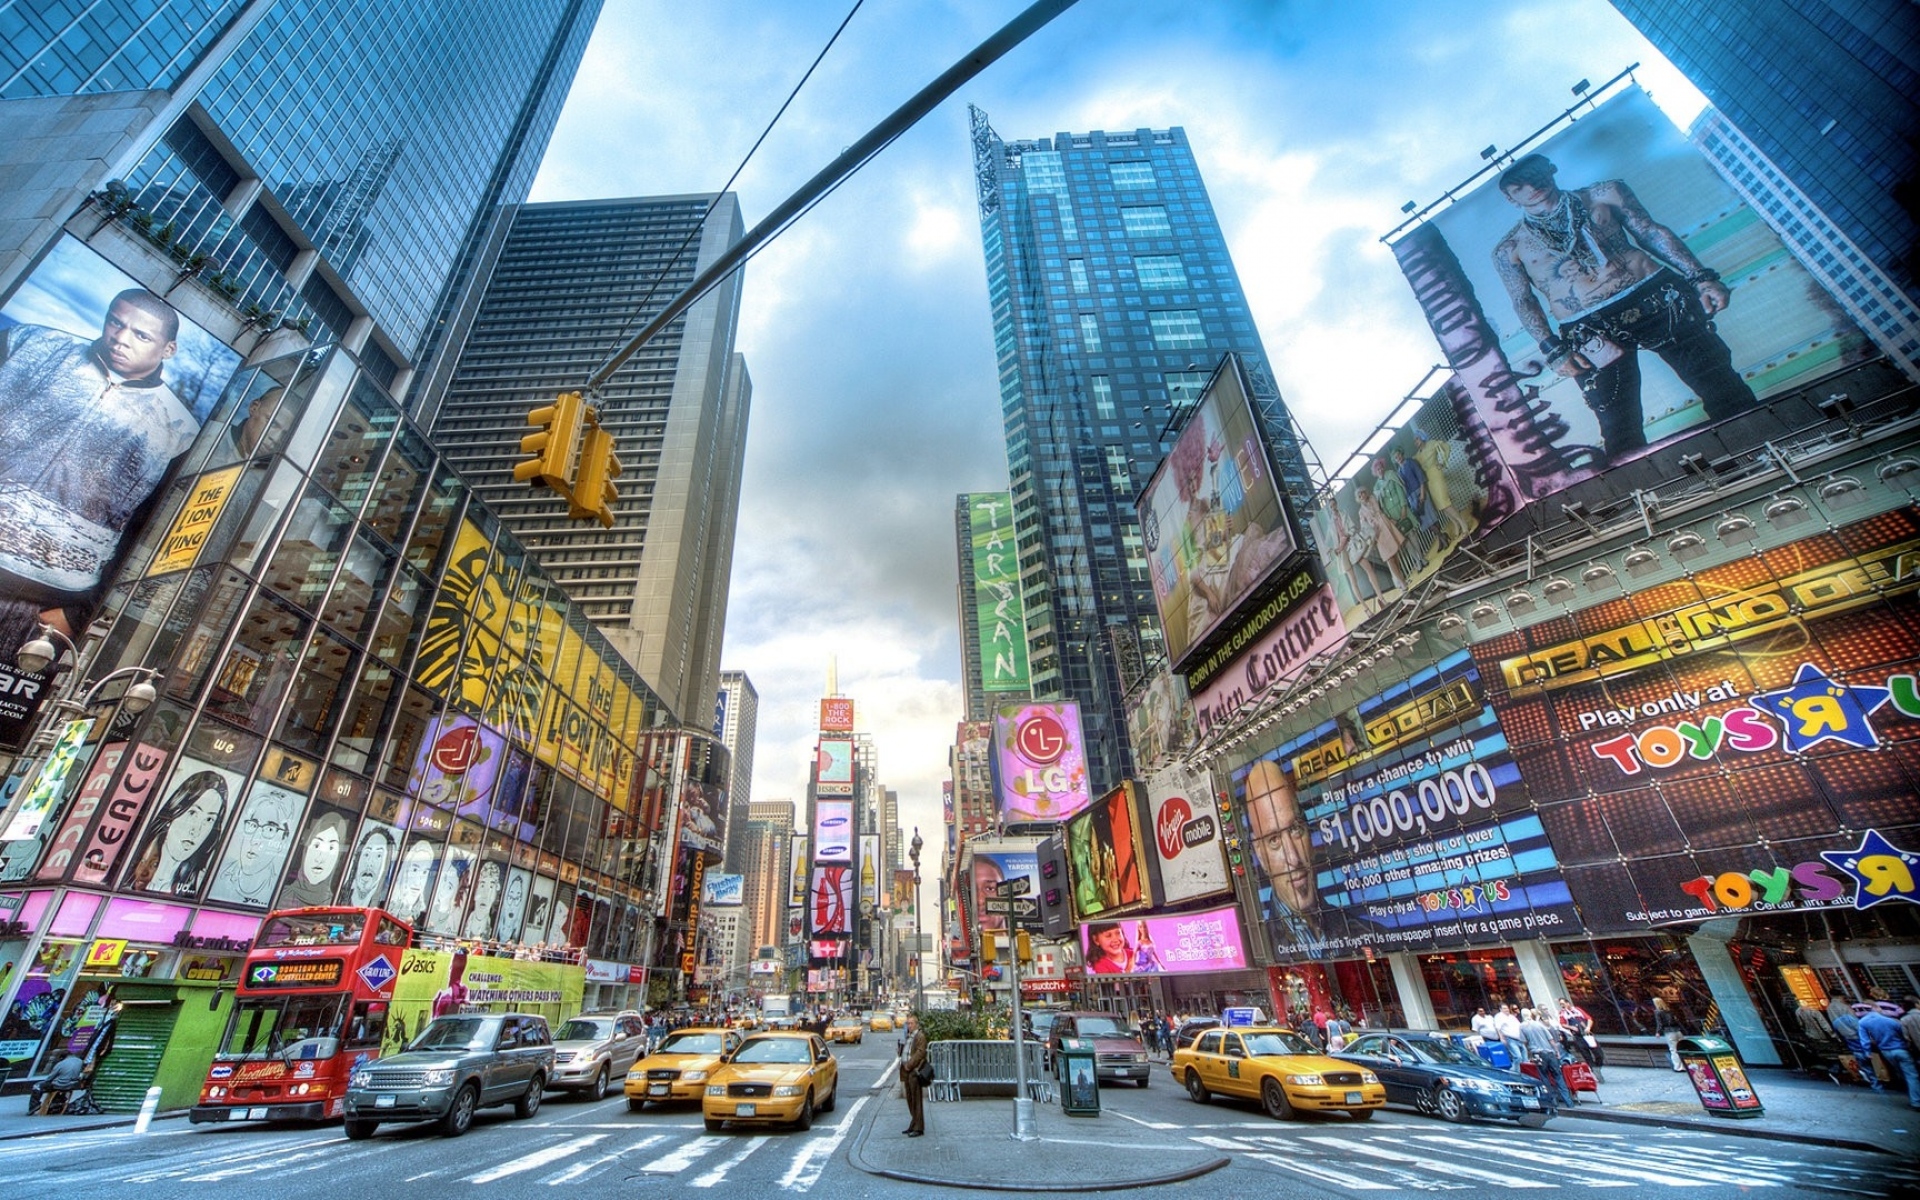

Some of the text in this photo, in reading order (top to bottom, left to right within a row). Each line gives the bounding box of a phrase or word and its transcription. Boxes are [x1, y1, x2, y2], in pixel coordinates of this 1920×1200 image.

[198, 487, 223, 503] THE
[176, 506, 218, 533] LION
[159, 532, 203, 561] KING
[1189, 571, 1314, 690] BORN IN THE GLAMOROUS USA
[1246, 596, 1339, 694] Couture
[1516, 632, 1657, 687] DEAL
[1681, 593, 1791, 640] NO
[588, 676, 611, 712] THE
[1578, 679, 1740, 732] Play only at
[547, 684, 594, 754] LION
[1367, 683, 1474, 745] NO DEAL
[213, 738, 235, 755] we
[1299, 742, 1345, 776] DEAL
[1592, 707, 1777, 775] TOYS
[337, 785, 351, 797] all
[1025, 767, 1068, 793] LG
[1322, 738, 1475, 806] Play for a chance to win
[46, 749, 123, 868] PEACE
[84, 751, 160, 872] PEACE
[1319, 762, 1497, 853] $1,000,000
[1160, 804, 1212, 852] Virgin mobile
[1341, 863, 1352, 874] or
[1361, 856, 1379, 873] trip
[1381, 854, 1391, 865] to
[1392, 848, 1412, 861] the
[1414, 843, 1448, 858] show,
[1449, 837, 1461, 847] or
[1467, 829, 1494, 843] over
[1344, 846, 1510, 891] 100,000 other amazing prizes!
[687, 851, 704, 951] KODAK digital
[1417, 889, 1460, 912] TOYS
[1483, 880, 1511, 902] US
[1680, 862, 1846, 911] TOYS
[992, 902, 1031, 911] ONE WAY
[1369, 902, 1416, 918] Play only at
[1626, 909, 1670, 924] Subject
[1670, 906, 1683, 918] to
[1278, 943, 1296, 955] Check
[1387, 929, 1434, 947] newspaper
[1434, 925, 1461, 937] insert
[1463, 921, 1478, 934] for
[1480, 923, 1488, 932] a
[1489, 919, 1522, 934] game
[1523, 912, 1563, 930] piece.
[280, 963, 339, 973] DOWNTOWN LOOP
[413, 959, 436, 974] asics
[1032, 981, 1061, 991] swatch
[469, 989, 563, 1002] WATCHING OTHERS PASS YOU
[229, 1061, 287, 1088] Broadway
